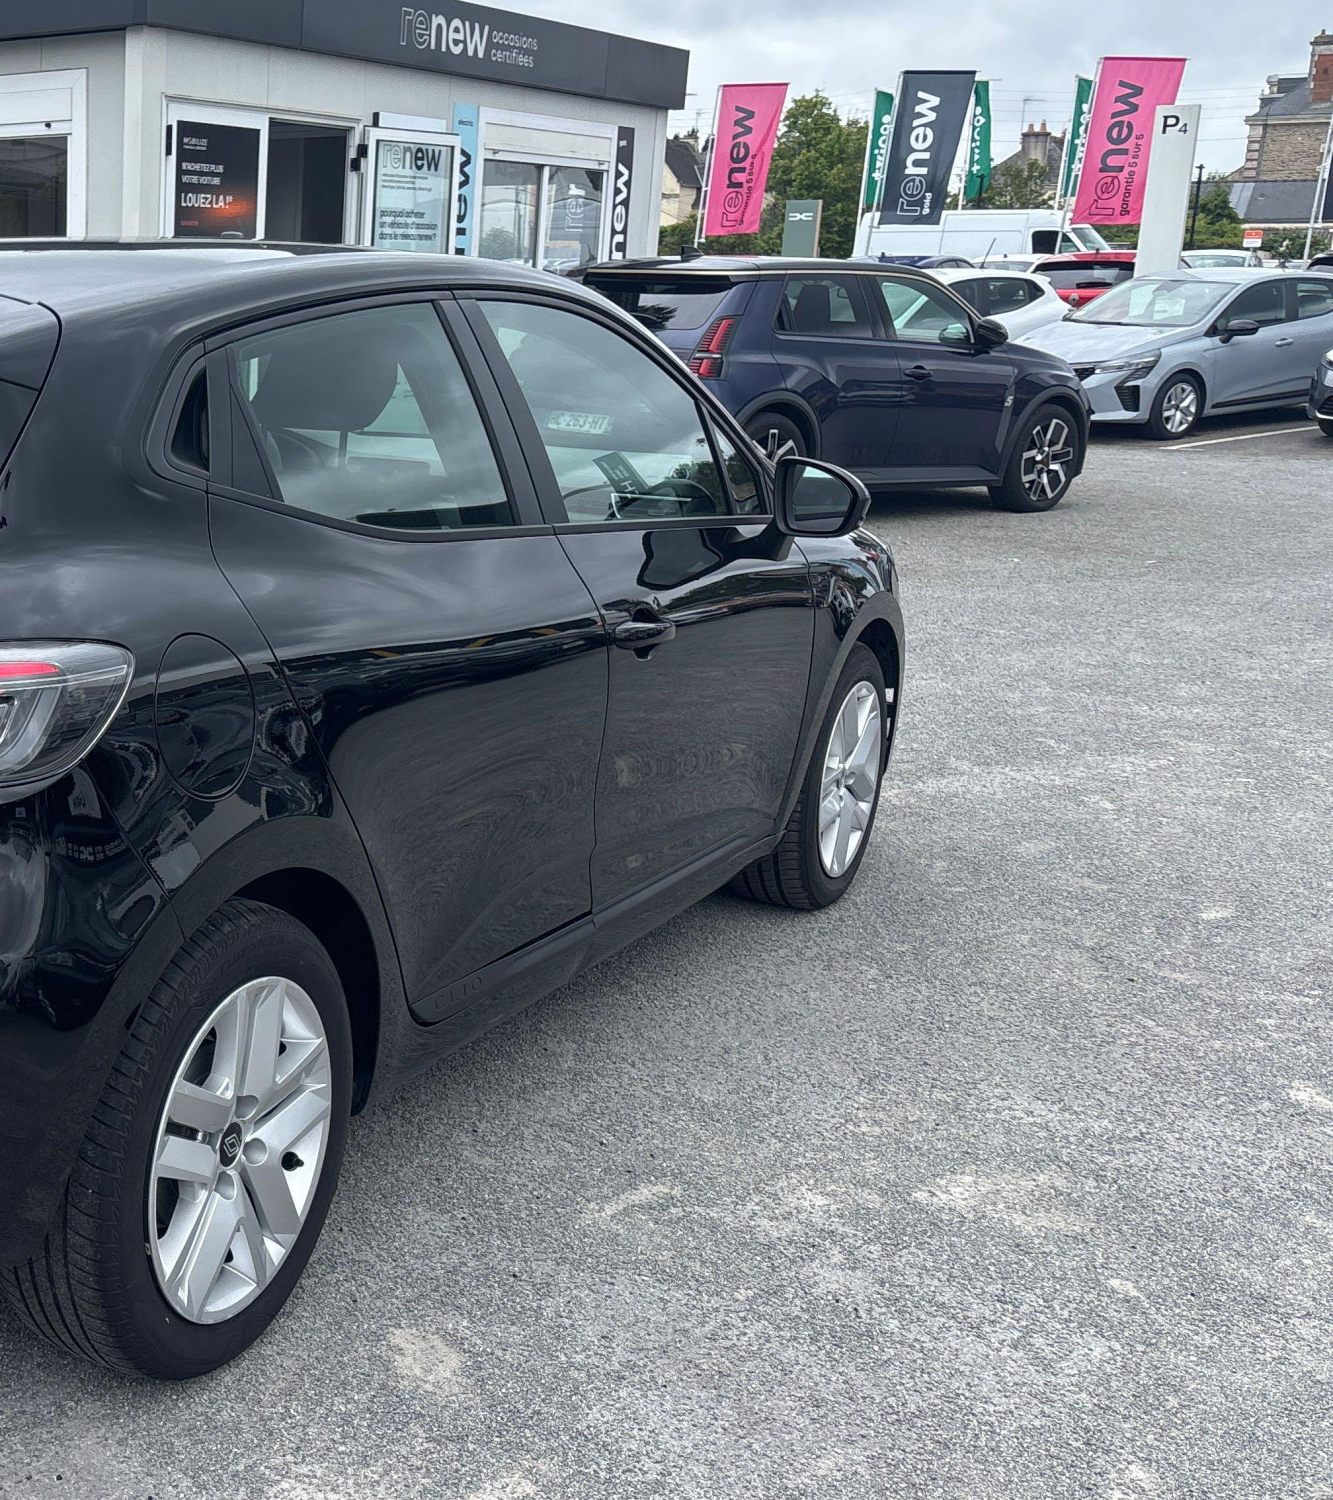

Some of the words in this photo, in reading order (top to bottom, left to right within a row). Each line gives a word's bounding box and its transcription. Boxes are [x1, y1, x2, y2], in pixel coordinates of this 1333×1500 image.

[400, 7, 490, 59] renew
[492, 30, 539, 51] occasions
[491, 48, 534, 68] certifiées
[382, 143, 442, 172] renew
[897, 90, 941, 216] renew
[1089, 79, 1145, 217] renew
[210, 164, 224, 173] PLUS
[721, 105, 756, 228] renew
[181, 175, 199, 183] VOTRE
[199, 176, 221, 185] VOITURE
[1119, 170, 1136, 217] garantie
[1132, 142, 1142, 160] sur
[181, 192, 212, 208] LOUEZ
[212, 194, 225, 209] LA
[922, 192, 933, 215] gold
[380, 209, 404, 219] pourquoi
[405, 209, 426, 219] acheter
[388, 219, 409, 229] véhicule
[409, 221, 438, 230] d'occasion
[379, 230, 393, 240] dans
